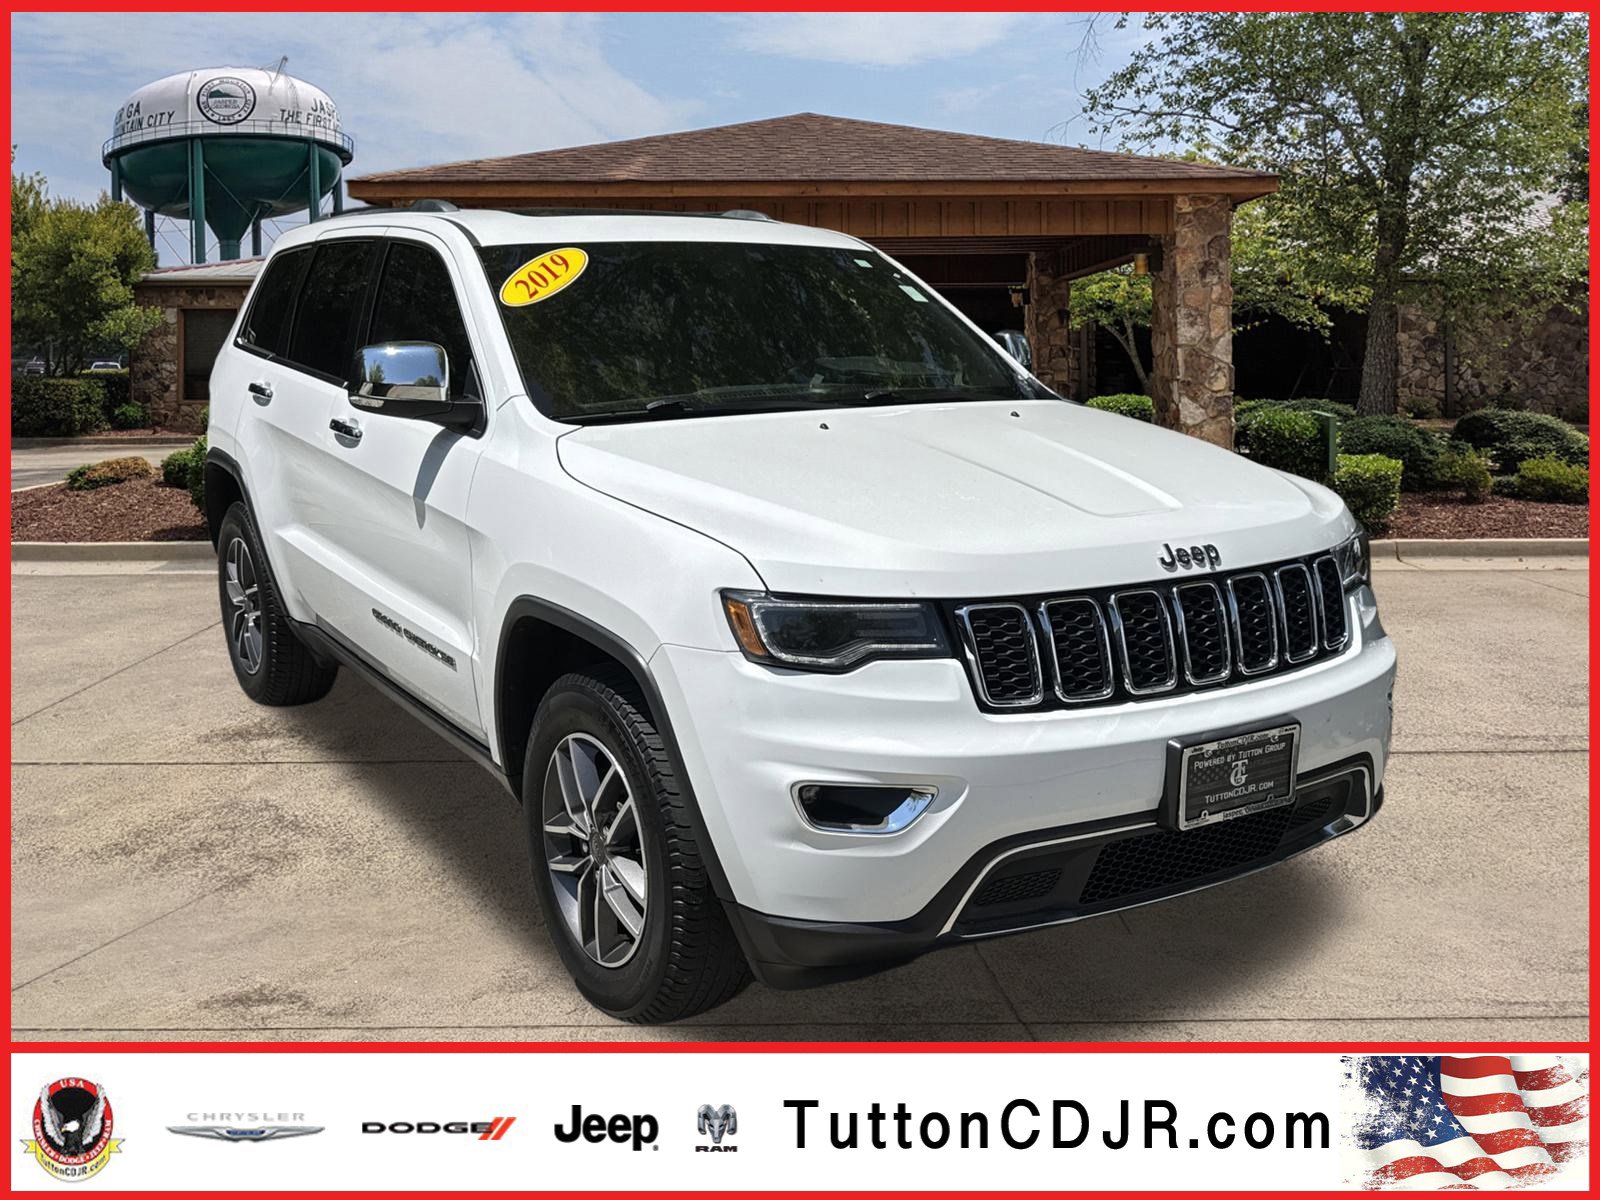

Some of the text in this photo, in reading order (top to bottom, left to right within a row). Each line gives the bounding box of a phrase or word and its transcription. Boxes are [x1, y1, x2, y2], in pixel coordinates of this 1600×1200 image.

[126, 101, 141, 119] GA
[147, 110, 175, 127] CITY
[279, 108, 302, 124] THE
[515, 254, 569, 299] 2019
[1158, 543, 1221, 569] Jeep
[1194, 742, 1286, 770] POWERED BY TUTTON GROUP
